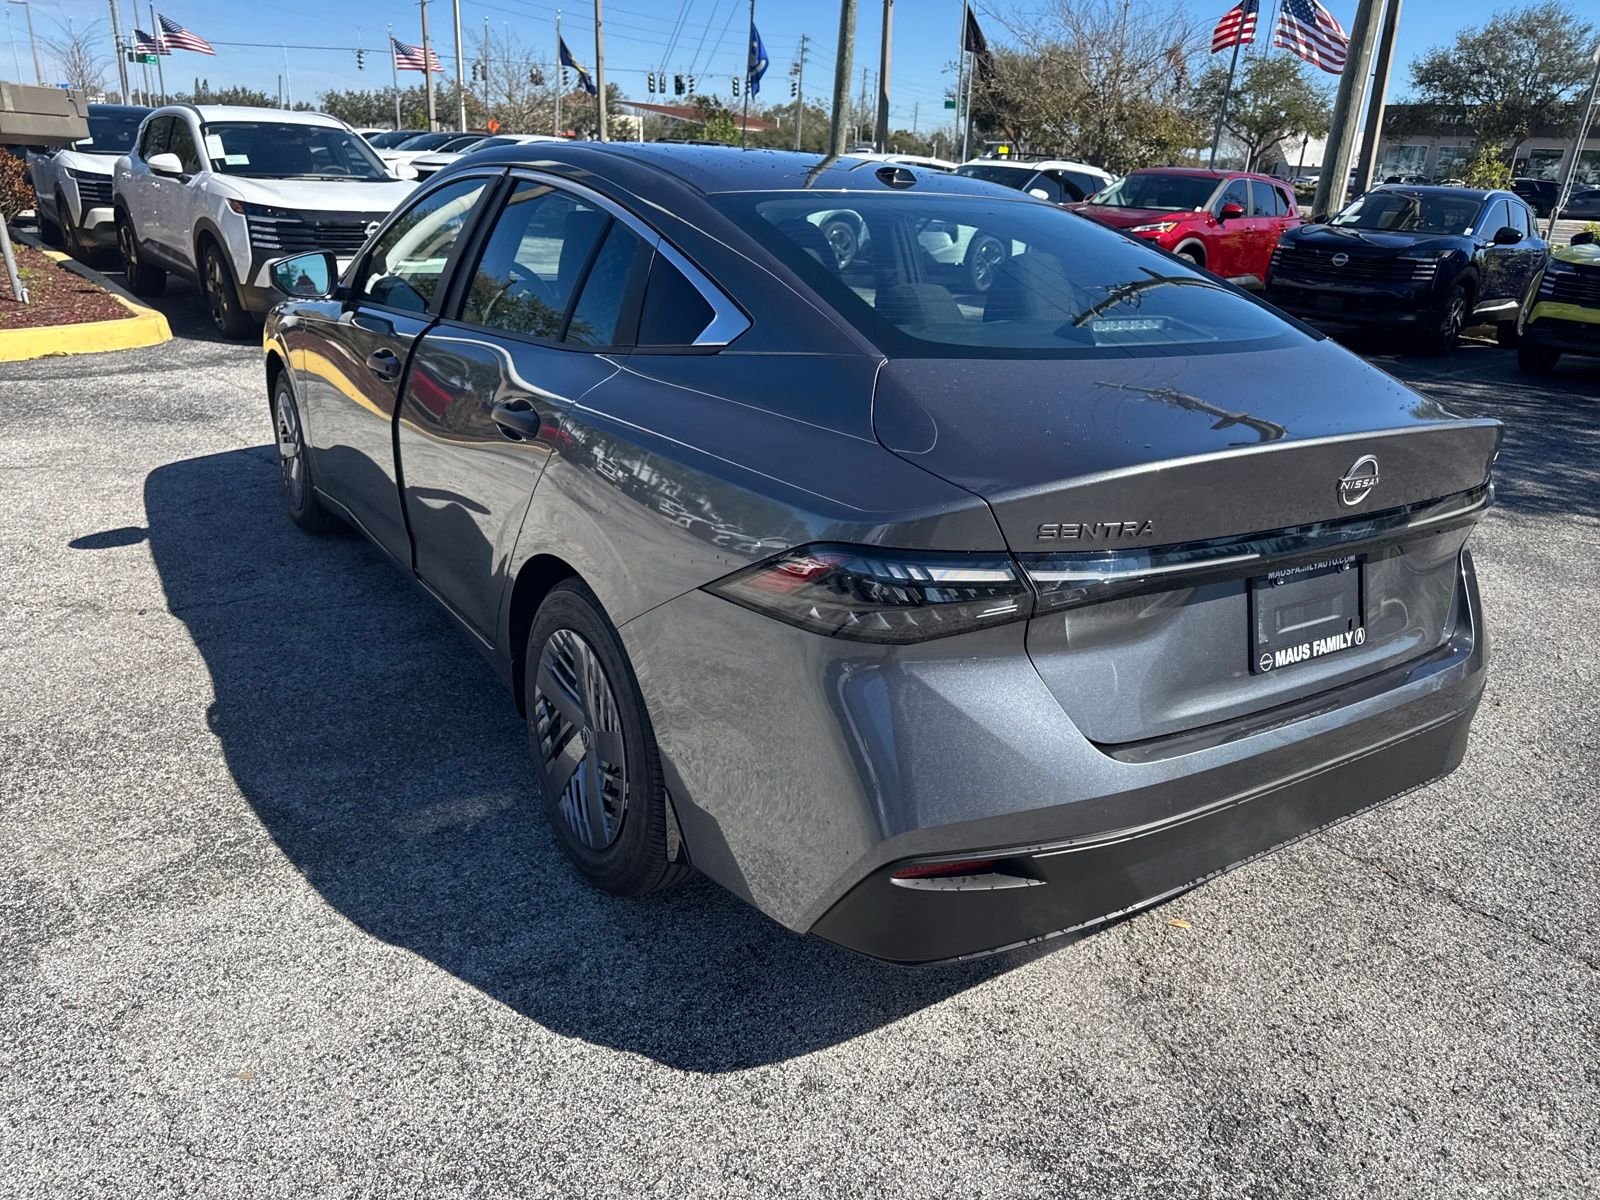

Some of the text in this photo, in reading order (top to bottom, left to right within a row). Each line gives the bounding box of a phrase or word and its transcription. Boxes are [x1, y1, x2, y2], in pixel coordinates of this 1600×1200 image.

[1340, 477, 1379, 490] NISSAN
[1037, 520, 1153, 540] SENTRA
[1275, 631, 1354, 668] MAUS FAMILY
